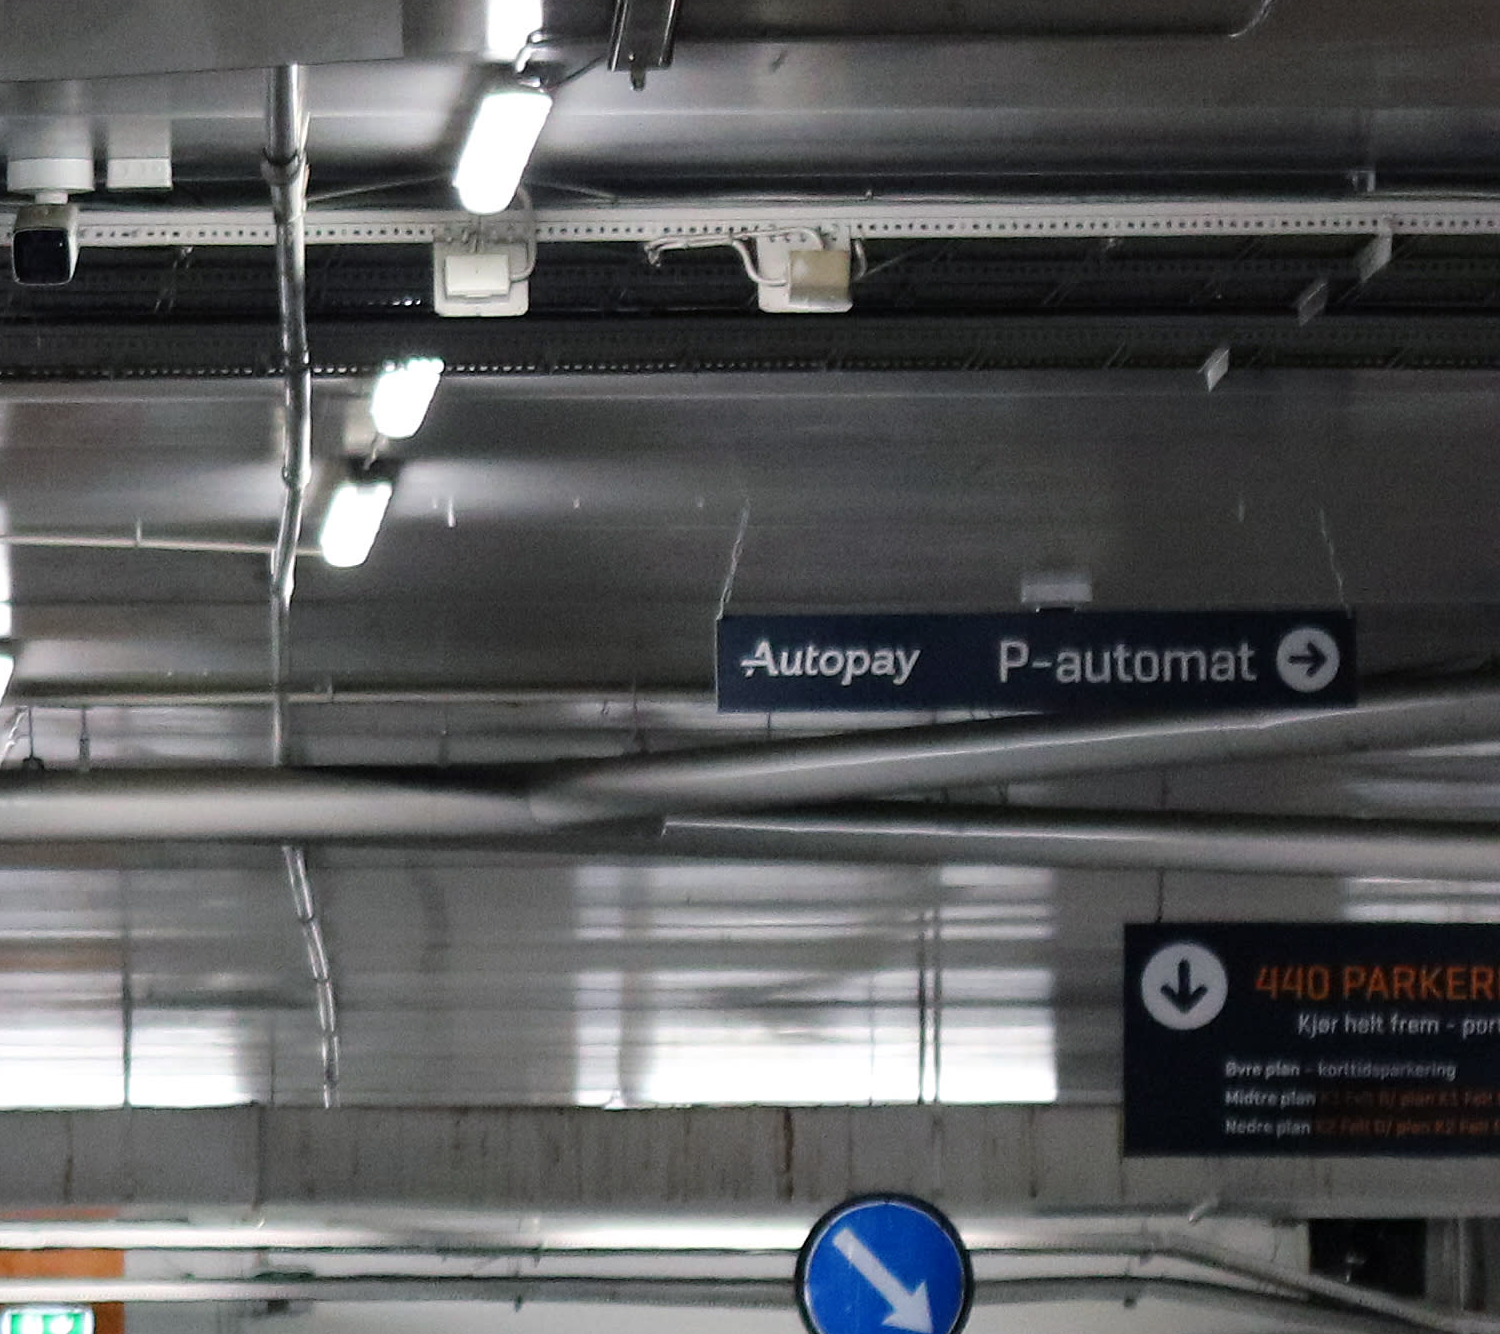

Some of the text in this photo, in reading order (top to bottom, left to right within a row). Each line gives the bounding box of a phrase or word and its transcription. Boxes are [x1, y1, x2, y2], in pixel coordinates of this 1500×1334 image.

[741, 640, 1258, 685] Autopay P-automat
[1256, 965, 1331, 1001] 440
[1298, 1014, 1340, 1039] Kjør
[1344, 1013, 1384, 1035] helt
[1390, 1013, 1440, 1035] frem
[1265, 1061, 1300, 1080] plan
[1225, 1089, 1277, 1105] Midtre
[1280, 1089, 1317, 1109] plan
[1225, 1120, 1273, 1135] Nedre
[1277, 1120, 1311, 1138] plan
